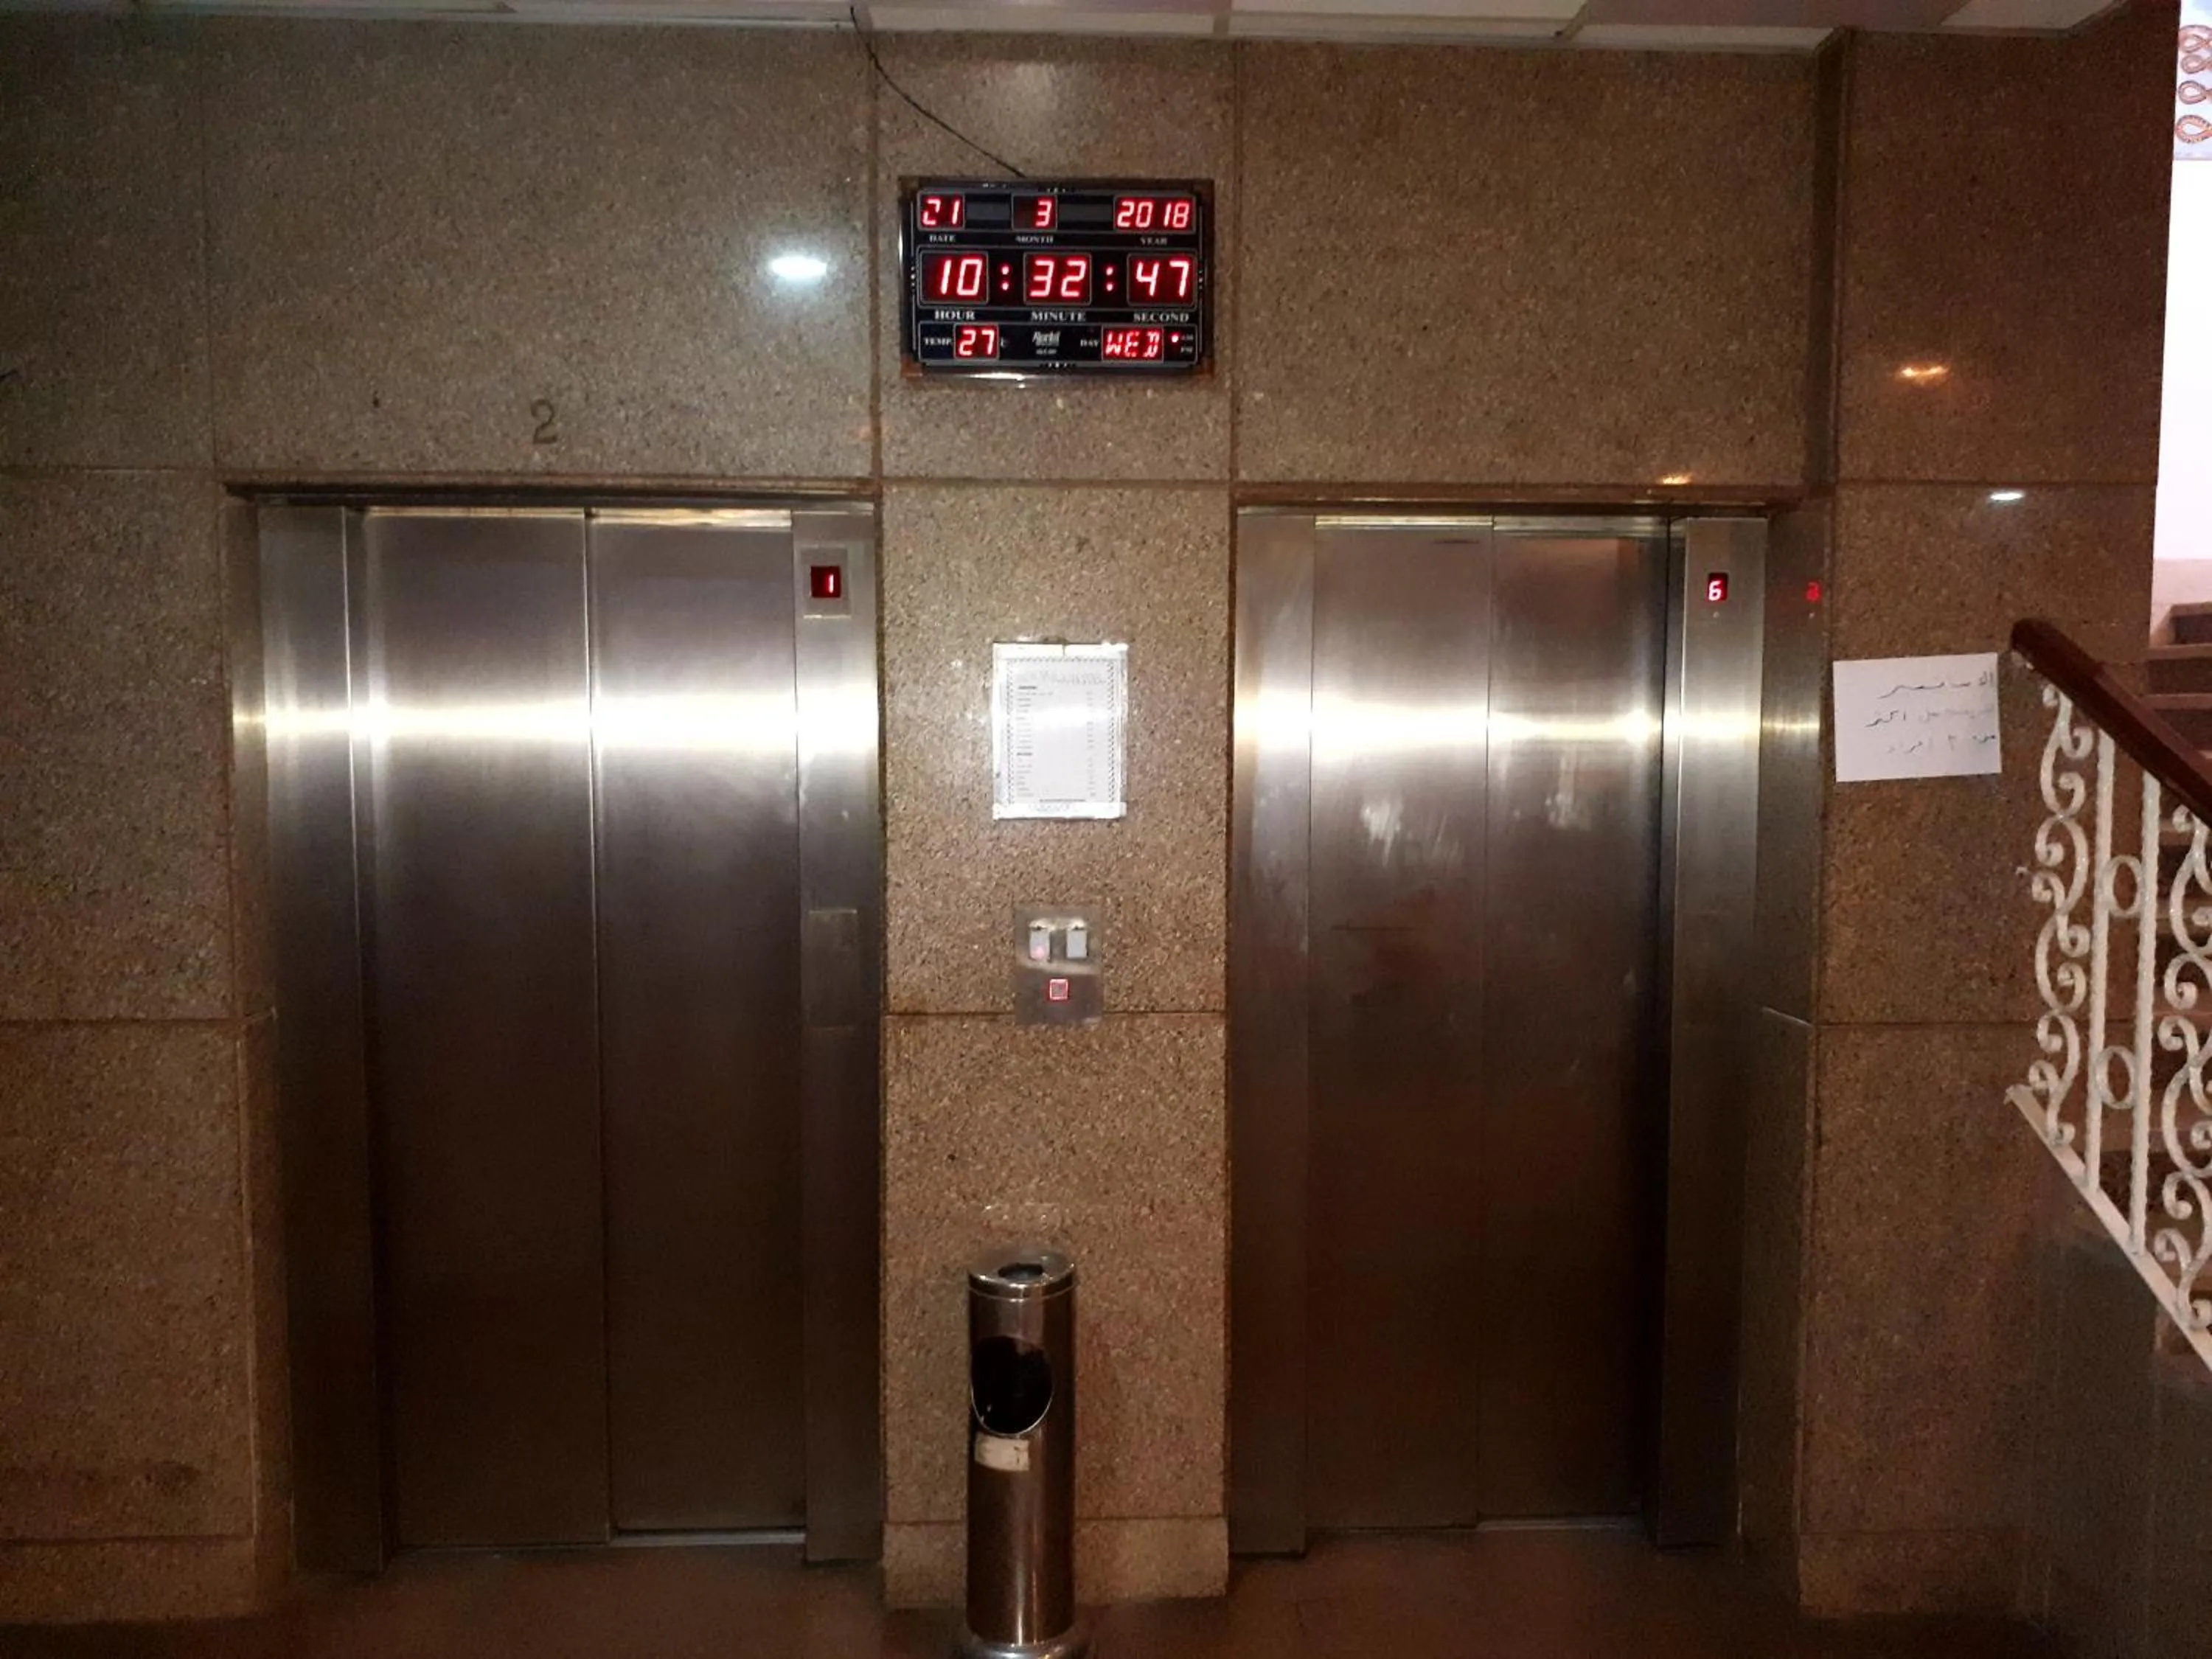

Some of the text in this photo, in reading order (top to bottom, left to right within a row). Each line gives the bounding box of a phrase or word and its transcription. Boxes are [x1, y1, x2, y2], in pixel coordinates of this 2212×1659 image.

[922, 198, 960, 226] 21
[1036, 200, 1052, 227] 3
[1117, 200, 1190, 228] 2018
[929, 234, 956, 243] DATE
[1015, 235, 1054, 244] MONTH
[1140, 237, 1168, 246] YEAR
[939, 257, 1189, 297] 10 32 47
[933, 310, 975, 321] HOUR
[1031, 310, 1086, 322] MINUTE
[1133, 312, 1189, 322] SECOND
[958, 329, 995, 356] 27
[1080, 330, 1160, 358] DAY WED
[530, 399, 557, 445] 2
[1707, 580, 1723, 602] 6
